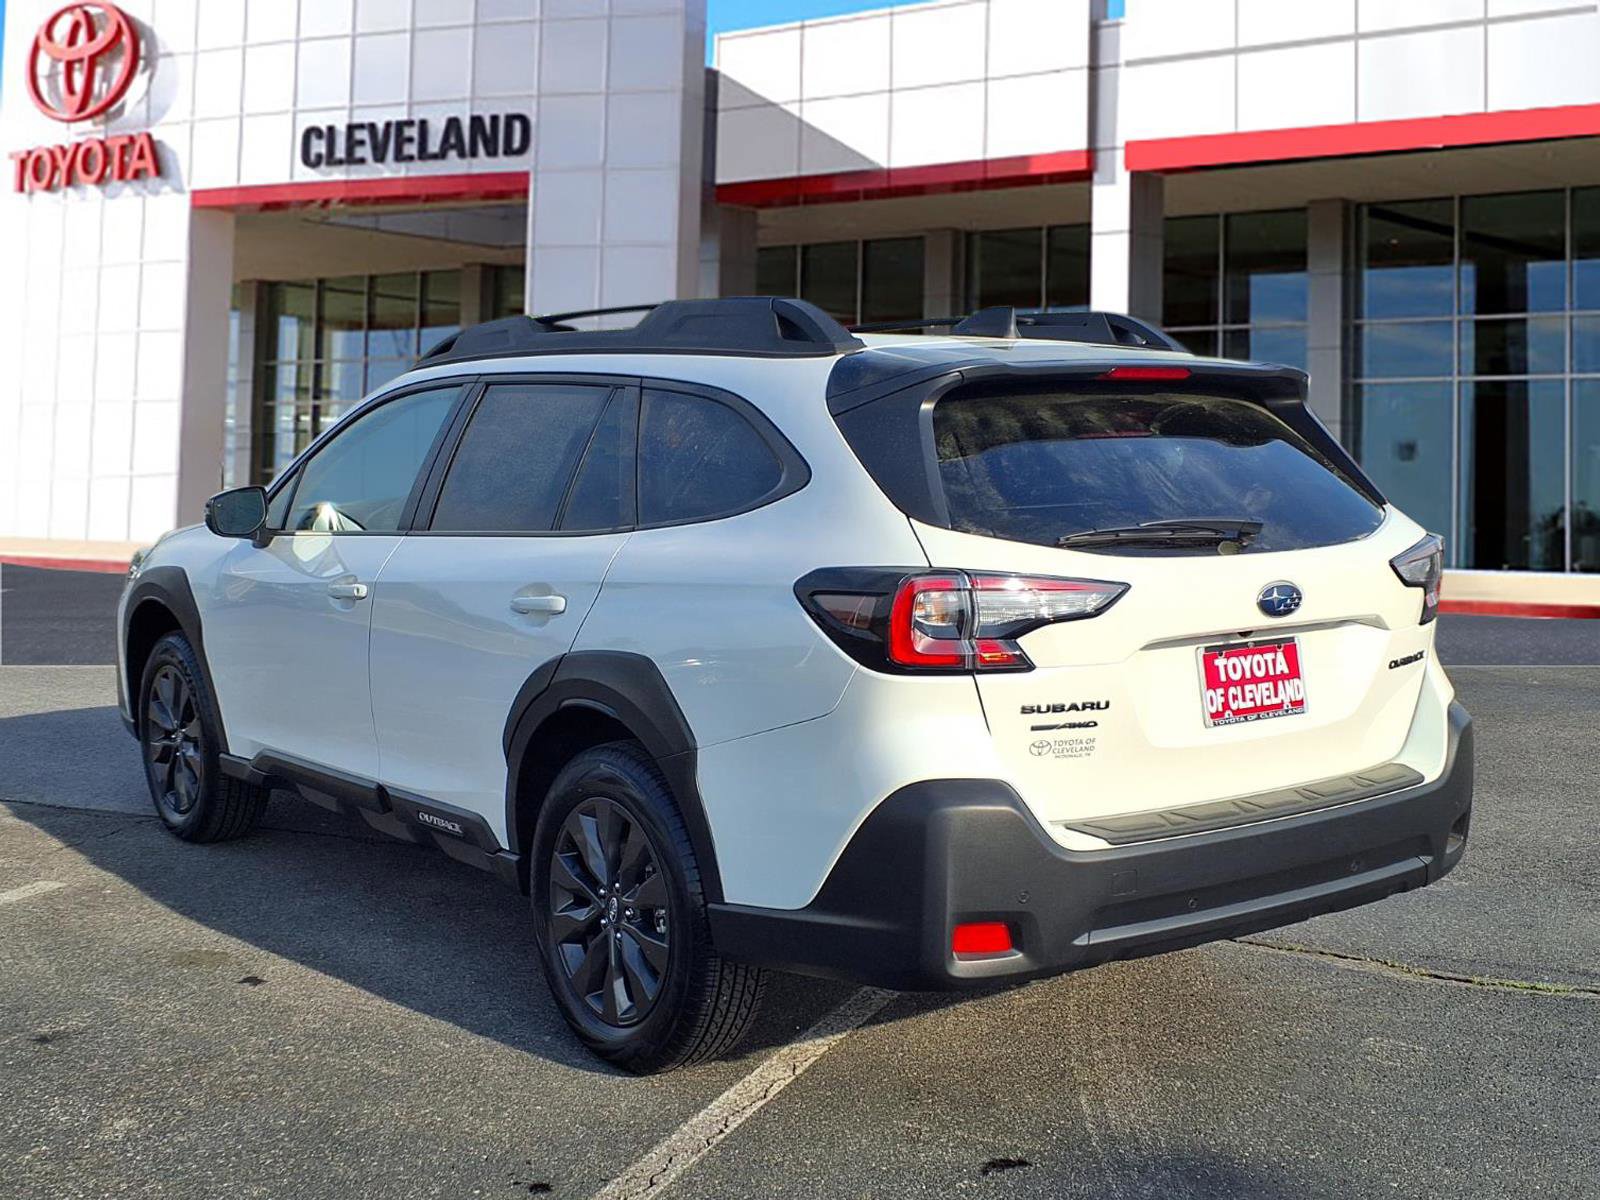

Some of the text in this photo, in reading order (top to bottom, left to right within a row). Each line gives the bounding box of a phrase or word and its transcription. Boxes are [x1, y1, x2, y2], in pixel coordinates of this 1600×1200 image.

[301, 113, 532, 170] CLEVELAND
[9, 131, 161, 194] TOYOTA
[1214, 652, 1289, 681] TOYOTA
[1020, 700, 1110, 714] SUBARU
[1206, 678, 1304, 714] OF CLEVELAND
[1214, 716, 1245, 726] TOYOTA
[1259, 709, 1304, 719] CLEVELAND
[1052, 745, 1096, 754] CLEVELAND
[1053, 737, 1097, 747] TOYOTA OF
[418, 811, 463, 834] OUTBACK
